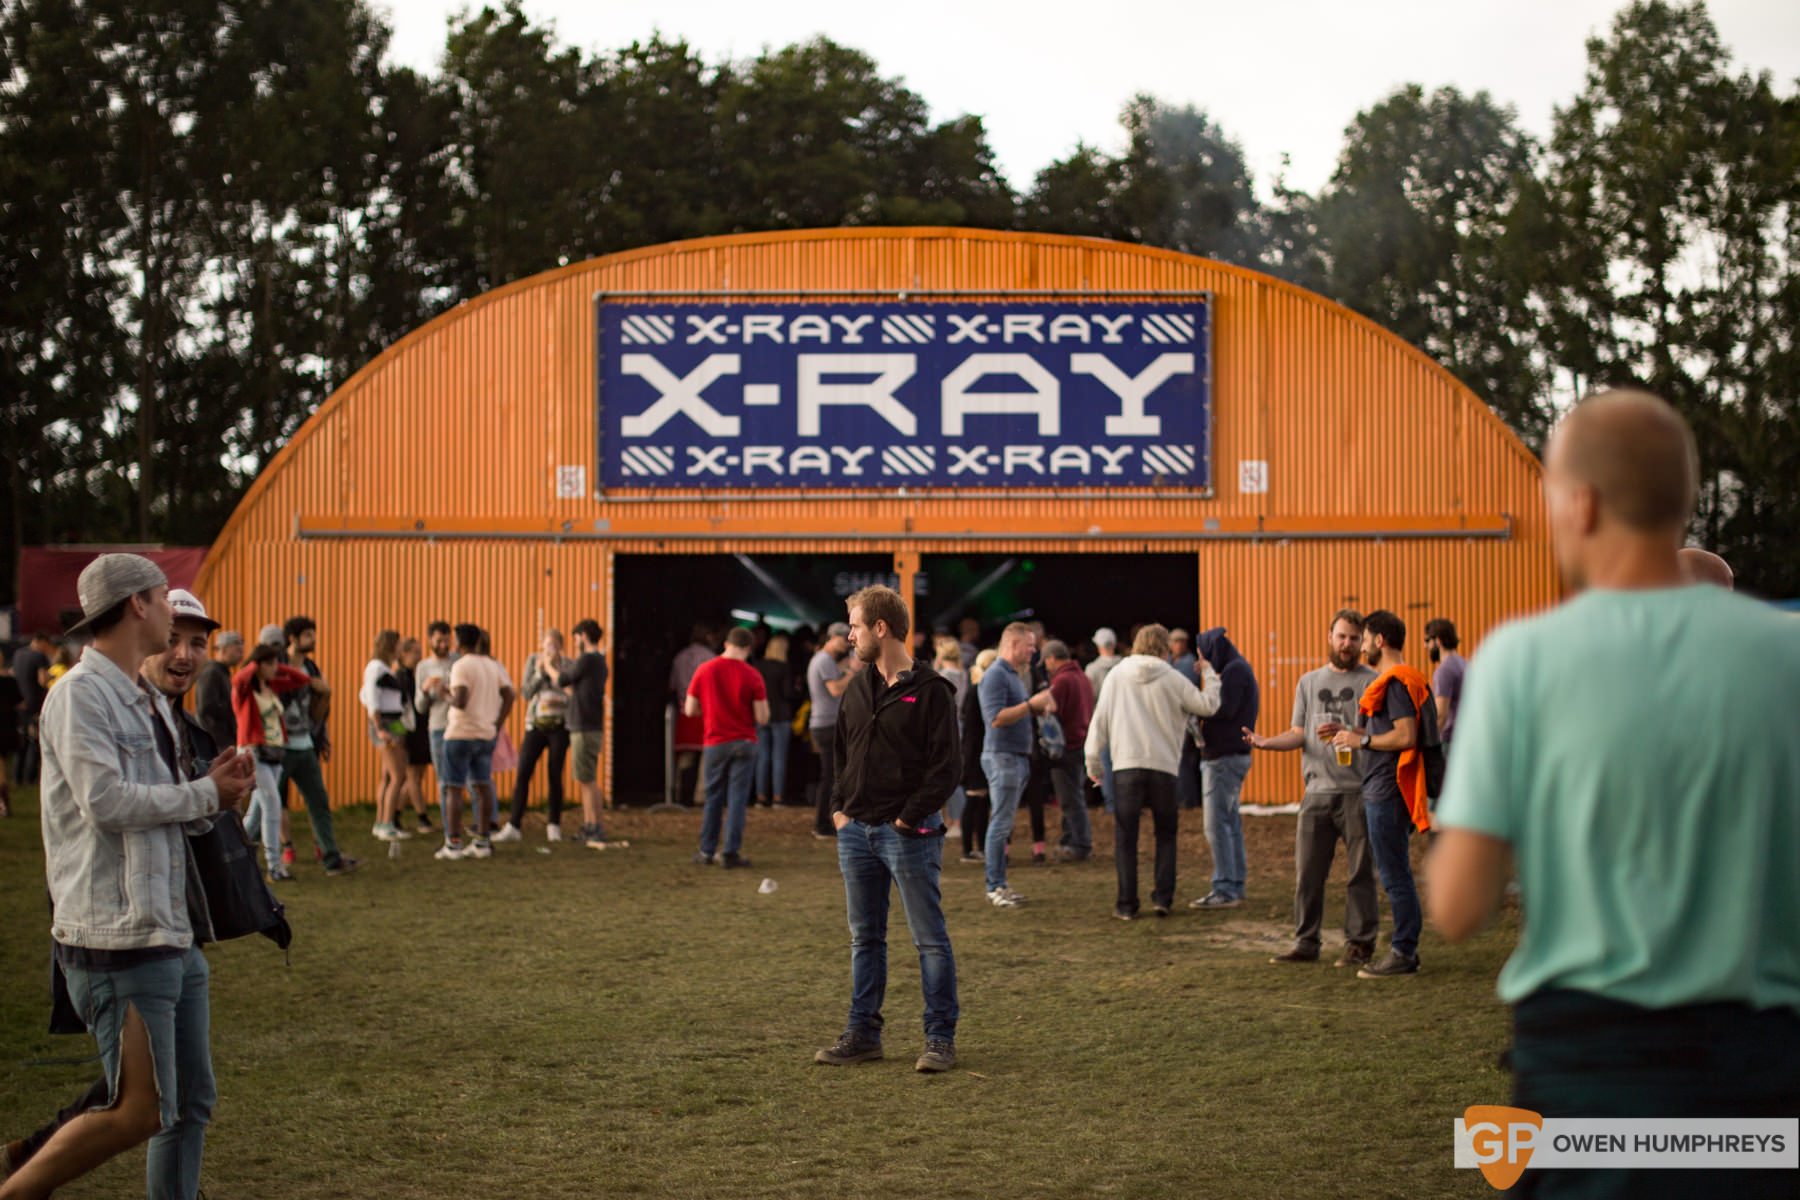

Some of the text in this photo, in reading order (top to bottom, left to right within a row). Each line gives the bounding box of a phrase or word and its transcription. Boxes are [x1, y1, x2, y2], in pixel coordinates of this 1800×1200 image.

[686, 314, 1134, 344] X-RAY X-RAY
[621, 353, 1195, 436] X-RAY
[686, 445, 1135, 476] X-RAY X-RAY
